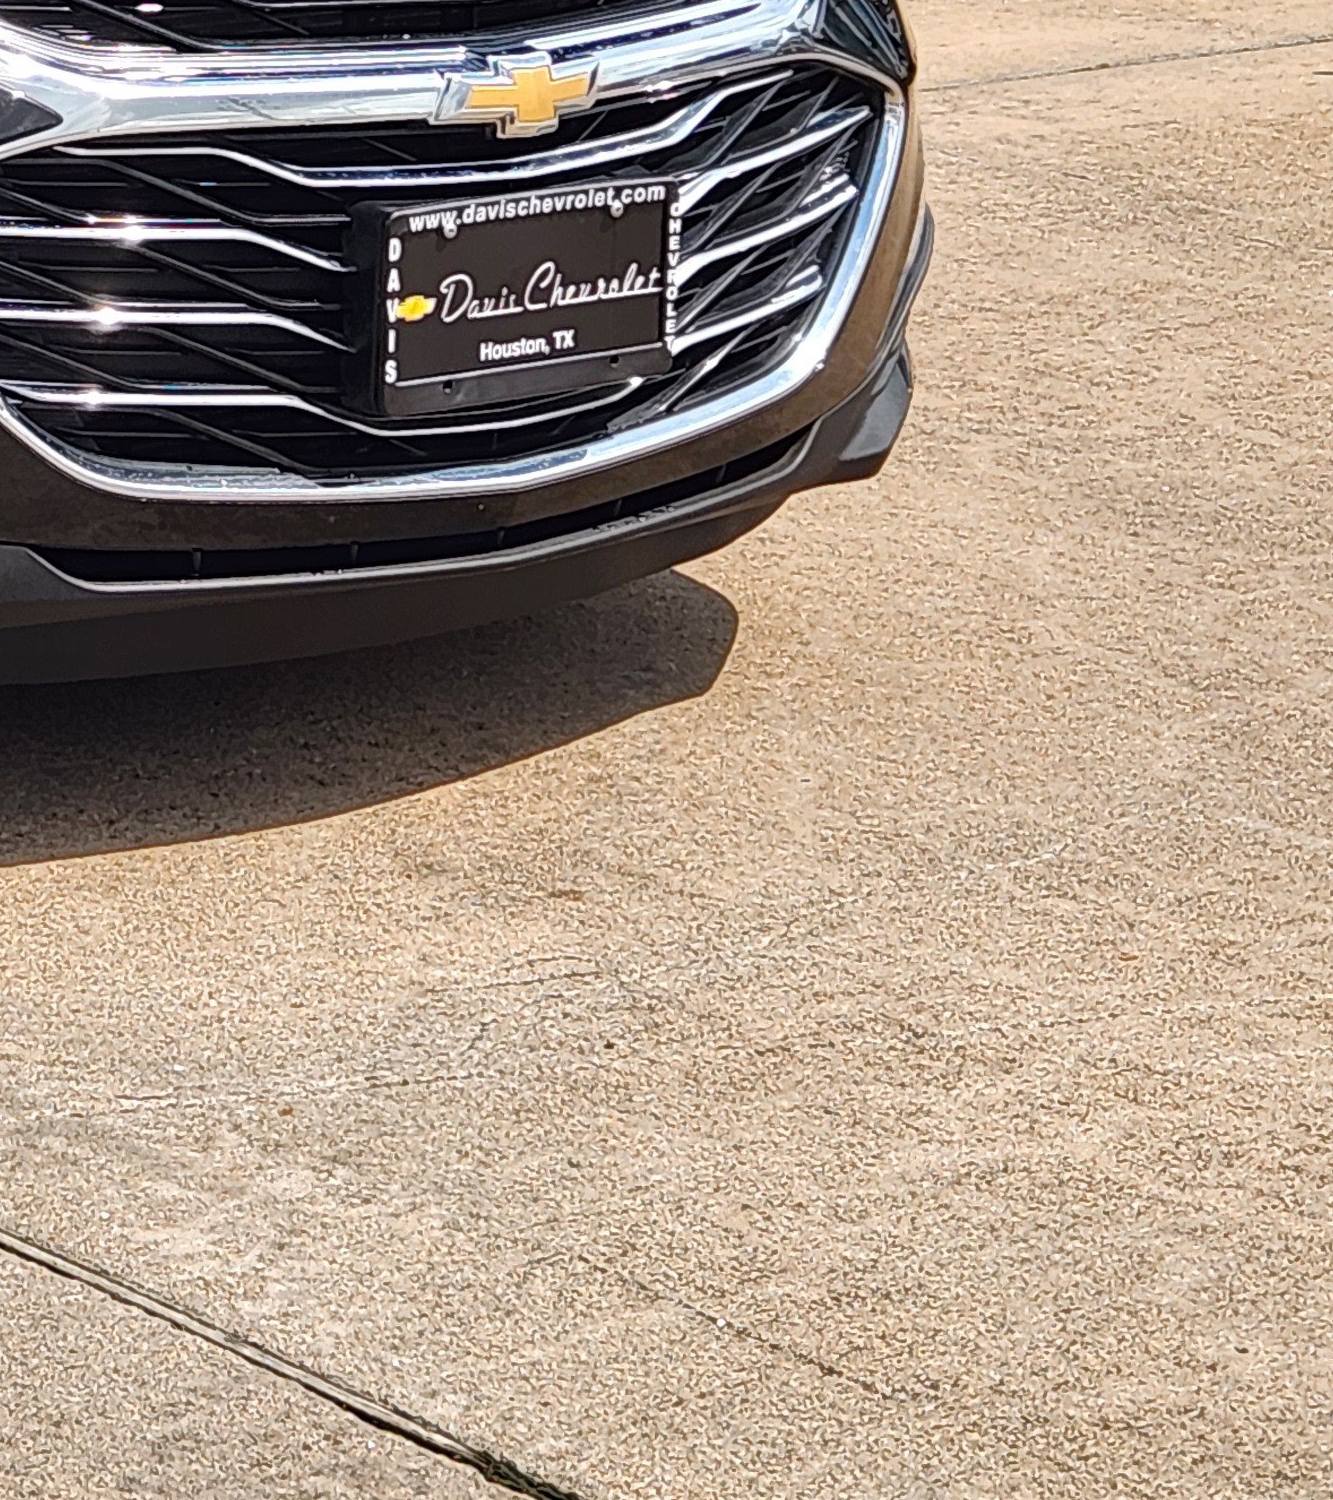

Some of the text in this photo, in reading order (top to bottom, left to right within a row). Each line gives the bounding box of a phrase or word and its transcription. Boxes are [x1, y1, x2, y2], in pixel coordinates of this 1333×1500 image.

[408, 184, 667, 233] www.davischevrolet.com
[384, 237, 403, 384] DAVIS
[439, 261, 664, 323] Davis Chevrolet
[480, 329, 575, 363] Houston, TX
